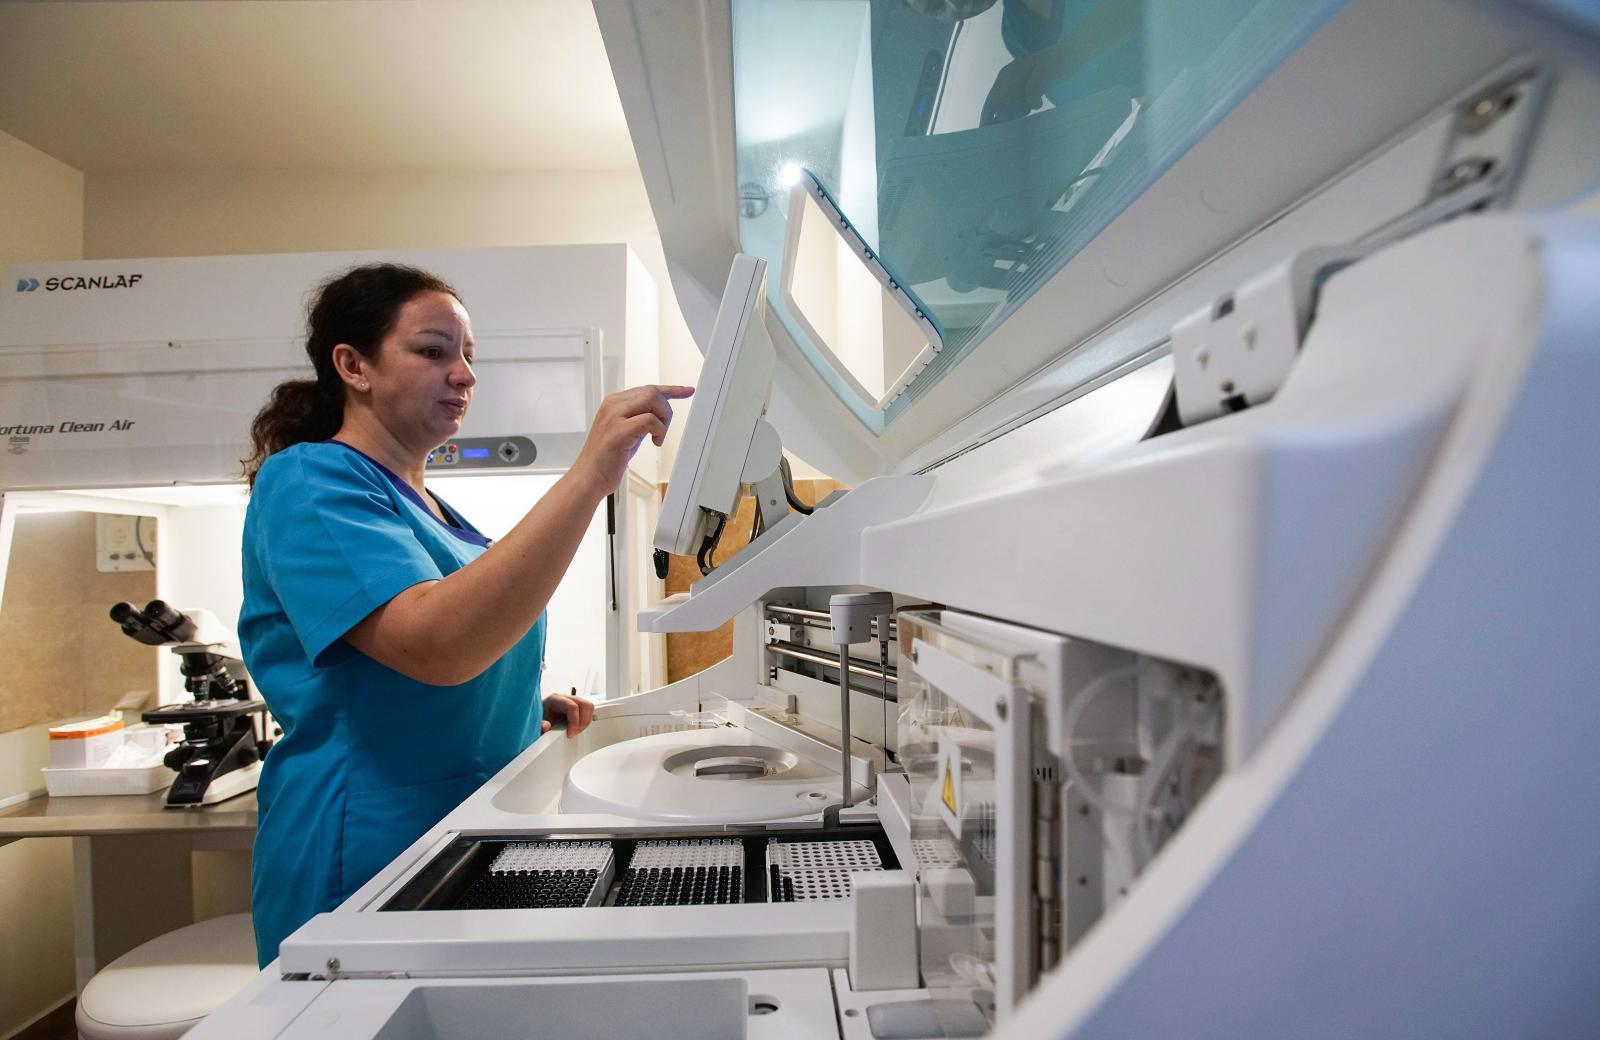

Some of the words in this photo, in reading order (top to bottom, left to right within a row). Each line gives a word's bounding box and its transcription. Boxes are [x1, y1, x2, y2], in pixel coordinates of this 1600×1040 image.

[45, 274, 142, 291] SCANLAF
[0, 424, 55, 435] ortuna
[59, 421, 105, 433] Clean
[108, 419, 135, 431] Air
